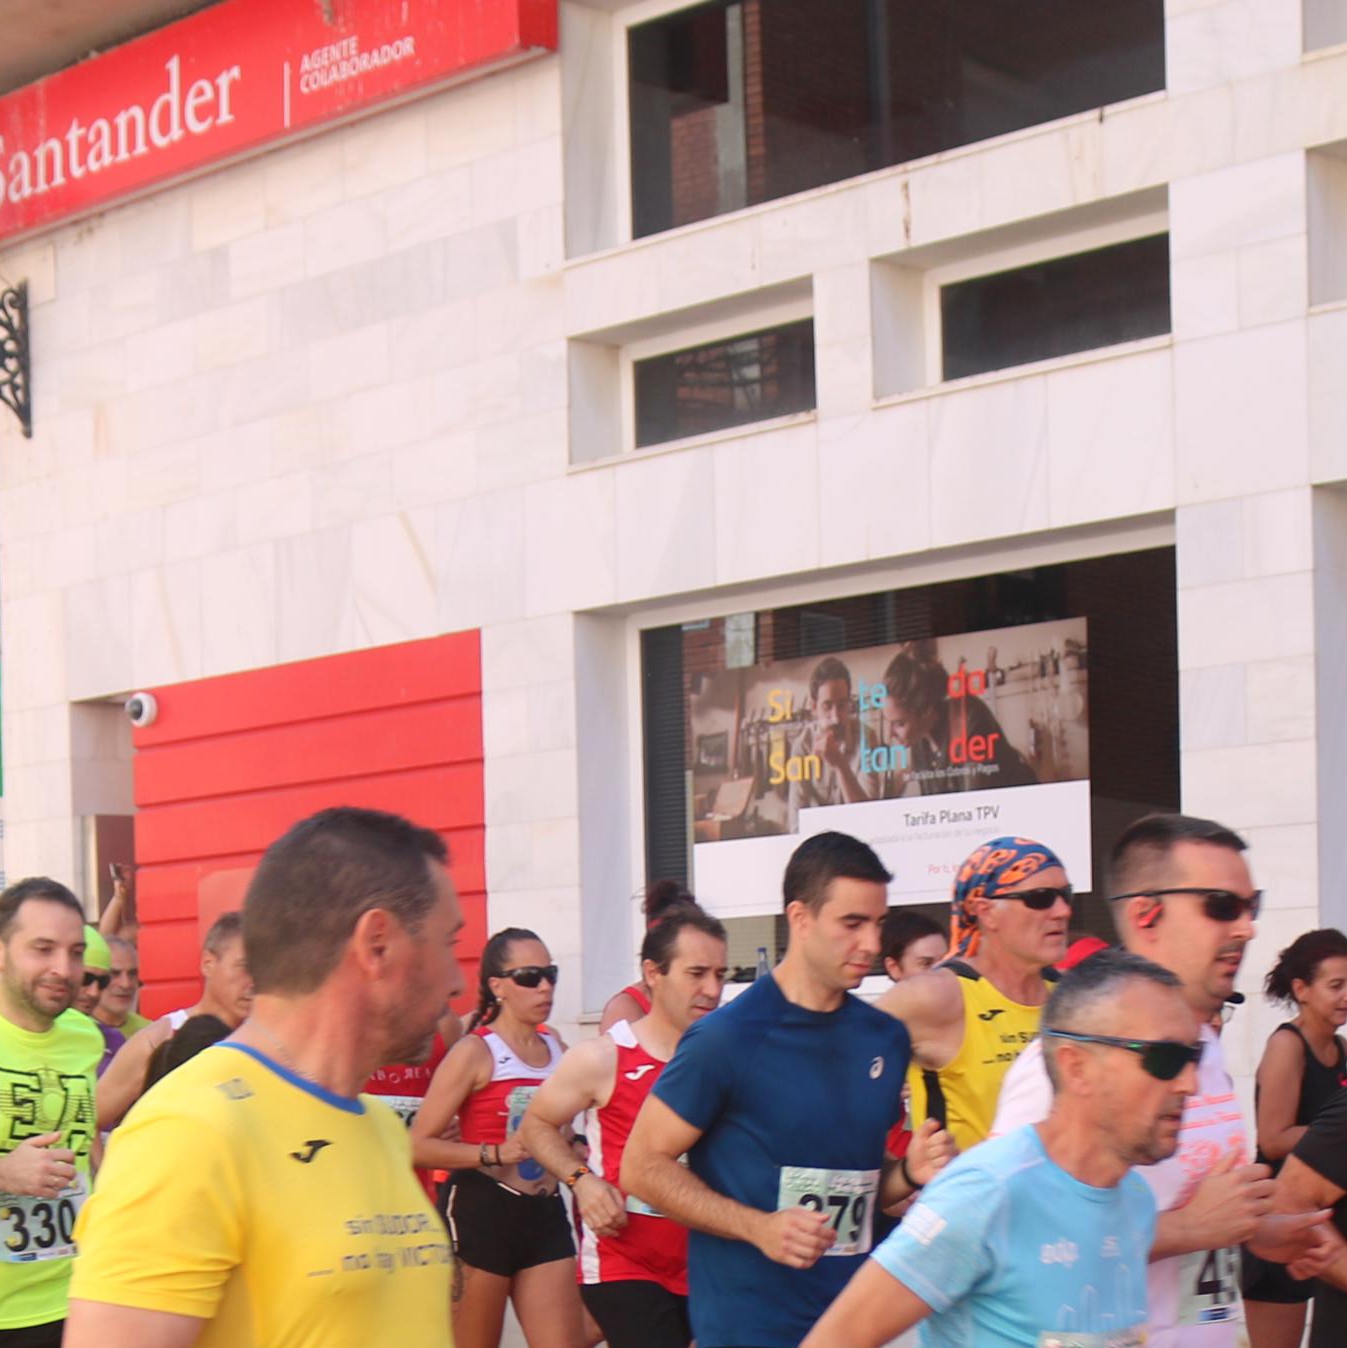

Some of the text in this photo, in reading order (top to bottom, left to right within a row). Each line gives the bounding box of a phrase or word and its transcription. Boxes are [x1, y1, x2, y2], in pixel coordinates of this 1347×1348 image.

[299, 35, 358, 74] AGENTE
[299, 36, 415, 94] COLABORADOR
[767, 660, 988, 723] Si te da
[769, 731, 1001, 785] San tan der
[904, 805, 1000, 827] Tarifa Plana TPV
[4, 1198, 76, 1252] 330
